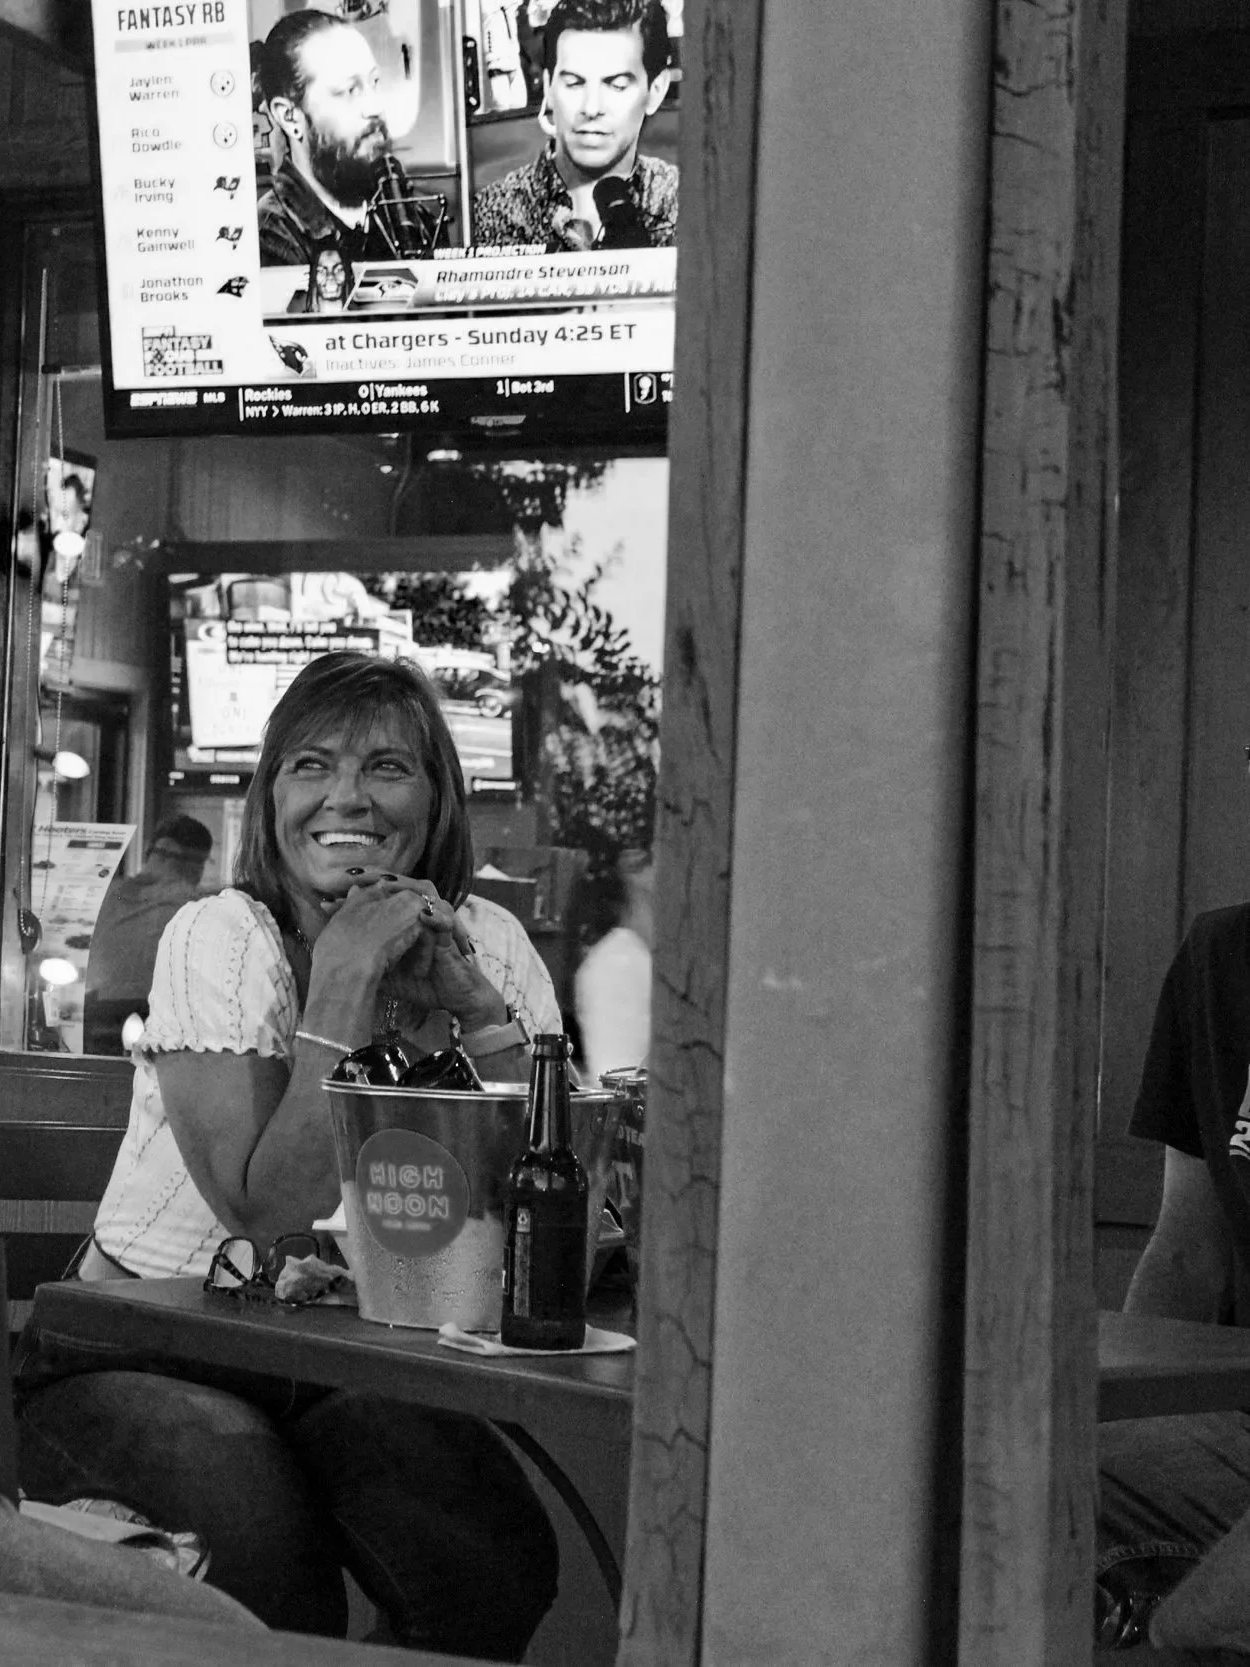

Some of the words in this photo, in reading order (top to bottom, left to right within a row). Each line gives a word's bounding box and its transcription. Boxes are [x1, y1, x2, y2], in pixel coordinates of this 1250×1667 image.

[118, 4, 196, 31] FANTASY
[202, 1, 225, 24] RB
[130, 76, 172, 88] Jaylen
[129, 90, 179, 101] Warren
[131, 128, 160, 138] Rico
[132, 140, 182, 152] Dowdle
[134, 178, 175, 189] Bucky
[134, 192, 174, 203] Irving
[137, 228, 179, 239] Kenny
[138, 240, 195, 252] Gainwell
[437, 269, 533, 284] Rhamondre
[539, 264, 630, 279] Stevenson
[140, 277, 203, 289] Jonathon
[140, 291, 188, 303] Brooks
[326, 335, 346, 350] at
[352, 332, 449, 352] Chargers
[468, 328, 548, 346] Sunday
[554, 325, 603, 342] 4:25
[610, 323, 637, 340] ET
[406, 355, 456, 369] James
[461, 352, 517, 366] Conner
[244, 388, 293, 402] Rockies
[375, 383, 428, 398] Yankees
[245, 405, 269, 418] NYY
[281, 404, 323, 417] Warren:
[370, 1163, 443, 1189] HIGH
[367, 1192, 449, 1218] NOON
